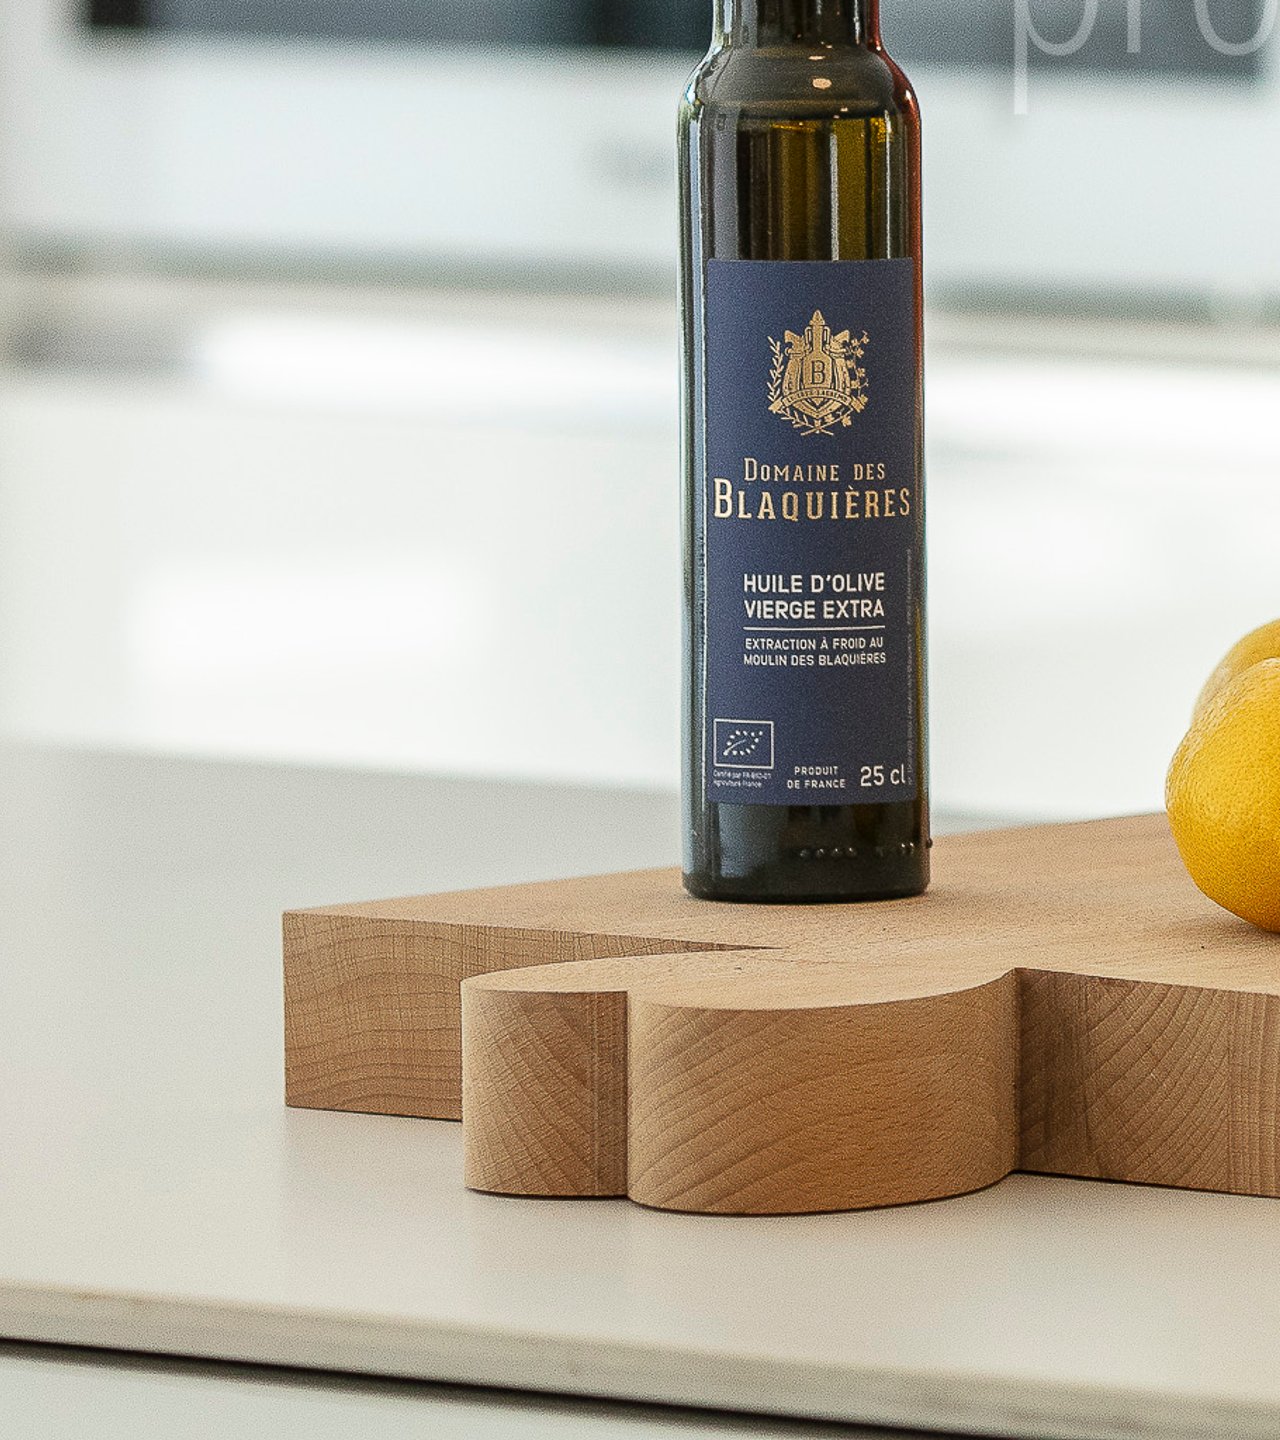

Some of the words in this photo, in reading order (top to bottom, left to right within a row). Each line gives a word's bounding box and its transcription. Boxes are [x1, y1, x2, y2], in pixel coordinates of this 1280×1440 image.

[811, 359, 826, 385] B
[713, 477, 911, 522] BLAQUIÈRES
[743, 573, 803, 593] HUILE
[811, 572, 885, 593] D'OLIVE
[744, 599, 816, 619] VIERGE
[823, 598, 885, 619] EXTRA
[745, 638, 816, 650] EXTRACTION
[820, 636, 829, 650] À
[832, 638, 866, 649] FROID
[869, 637, 884, 648] AU
[743, 654, 787, 666] MOULIN
[791, 654, 814, 666] DES
[818, 651, 886, 666] BLAQUIÈRES
[794, 766, 839, 776] PRODUIT
[860, 765, 885, 787] 25
[891, 763, 906, 785] cl
[786, 779, 800, 789] DE
[804, 779, 846, 789] FRANCE
